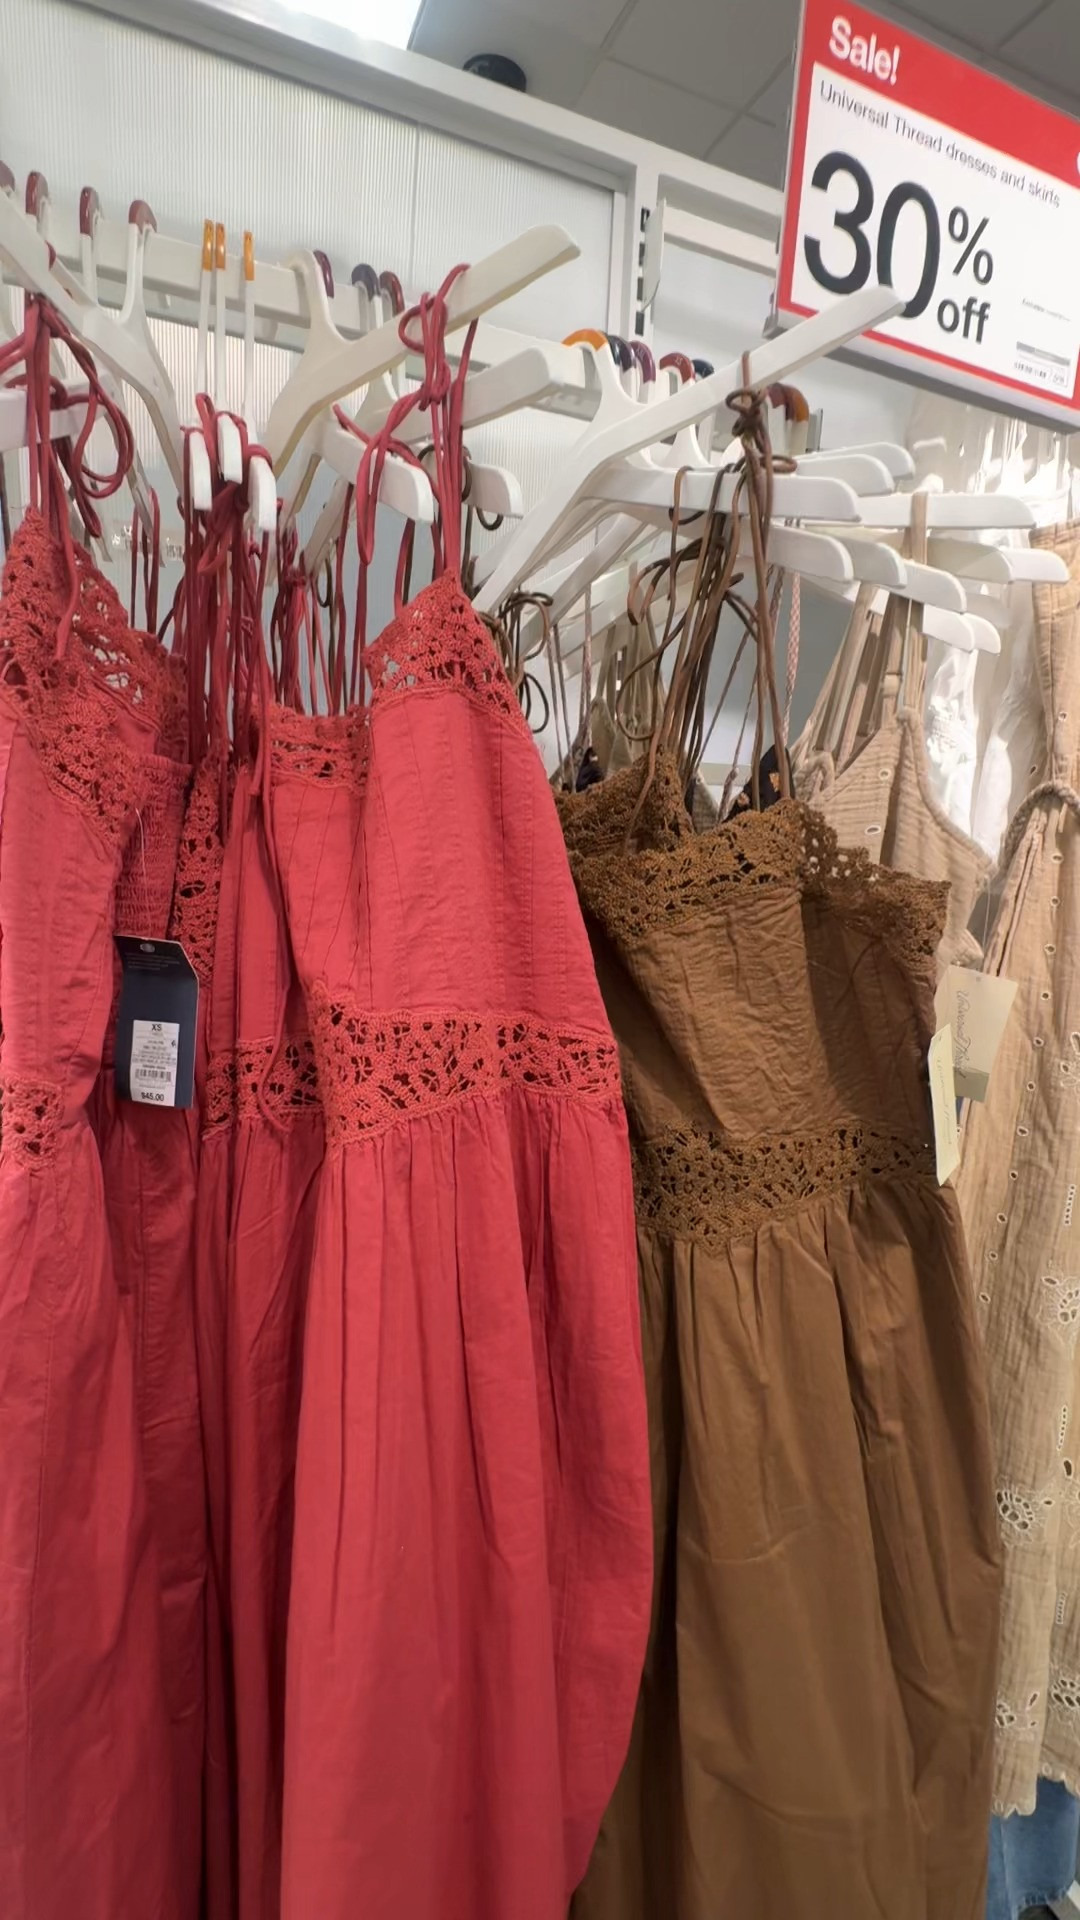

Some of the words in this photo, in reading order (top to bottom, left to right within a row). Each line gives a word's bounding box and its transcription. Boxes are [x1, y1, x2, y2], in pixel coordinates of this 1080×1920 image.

[828, 15, 900, 85] Sale!
[819, 80, 889, 129] Universal
[894, 113, 943, 153] Thread
[946, 141, 998, 179] dresses
[1000, 169, 1026, 191] and
[1028, 180, 1061, 208] skirts
[937, 297, 992, 344] off
[151, 1023, 162, 1032] XS
[141, 1091, 165, 1102] $45.00
